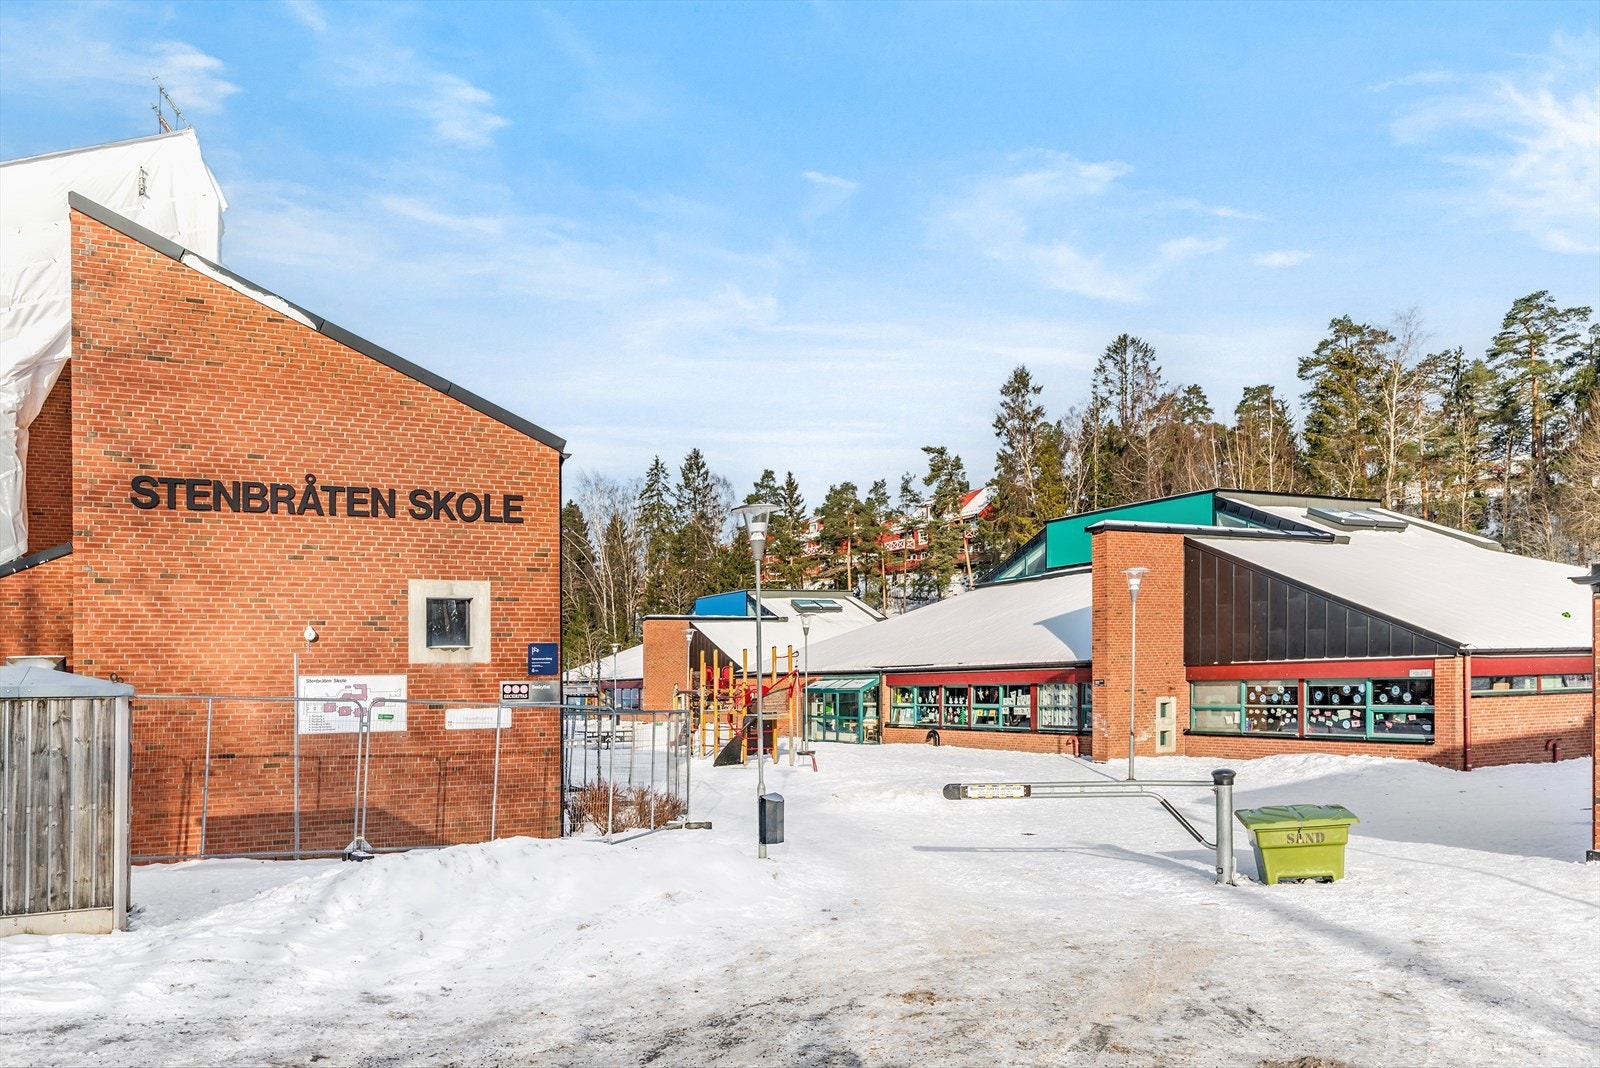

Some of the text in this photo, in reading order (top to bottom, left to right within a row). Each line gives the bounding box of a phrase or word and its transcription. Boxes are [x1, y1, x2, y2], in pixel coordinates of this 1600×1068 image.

[131, 474, 524, 524] STENBRÅTEN SKOLE
[1286, 832, 1325, 844] SAND
